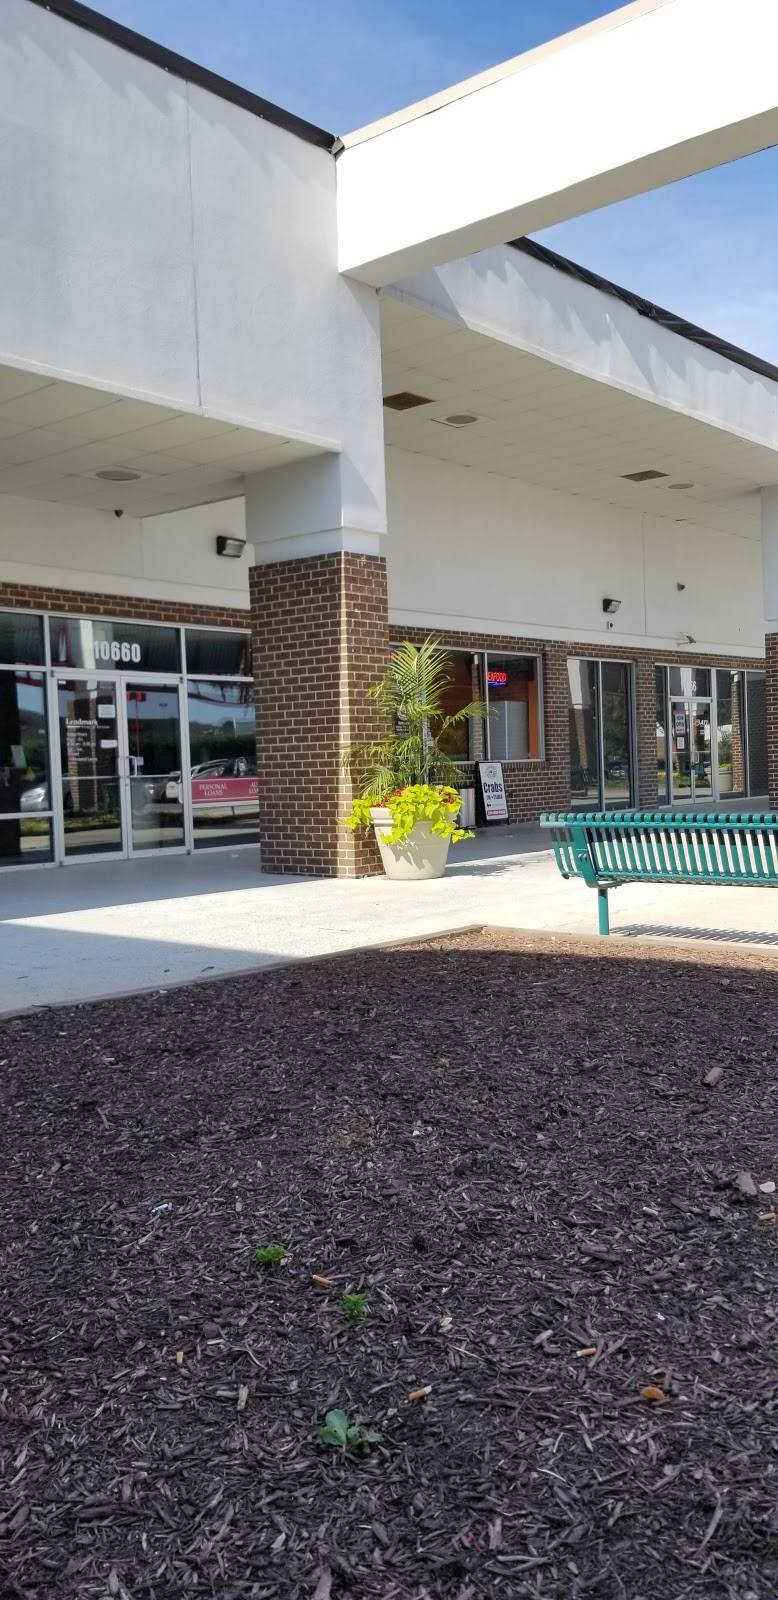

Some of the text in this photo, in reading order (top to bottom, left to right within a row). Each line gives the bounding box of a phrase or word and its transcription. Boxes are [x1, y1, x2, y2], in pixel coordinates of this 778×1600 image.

[94, 640, 141, 663] 10660
[487, 671, 507, 682] EAFOOD
[483, 781, 503, 793] Crabs
